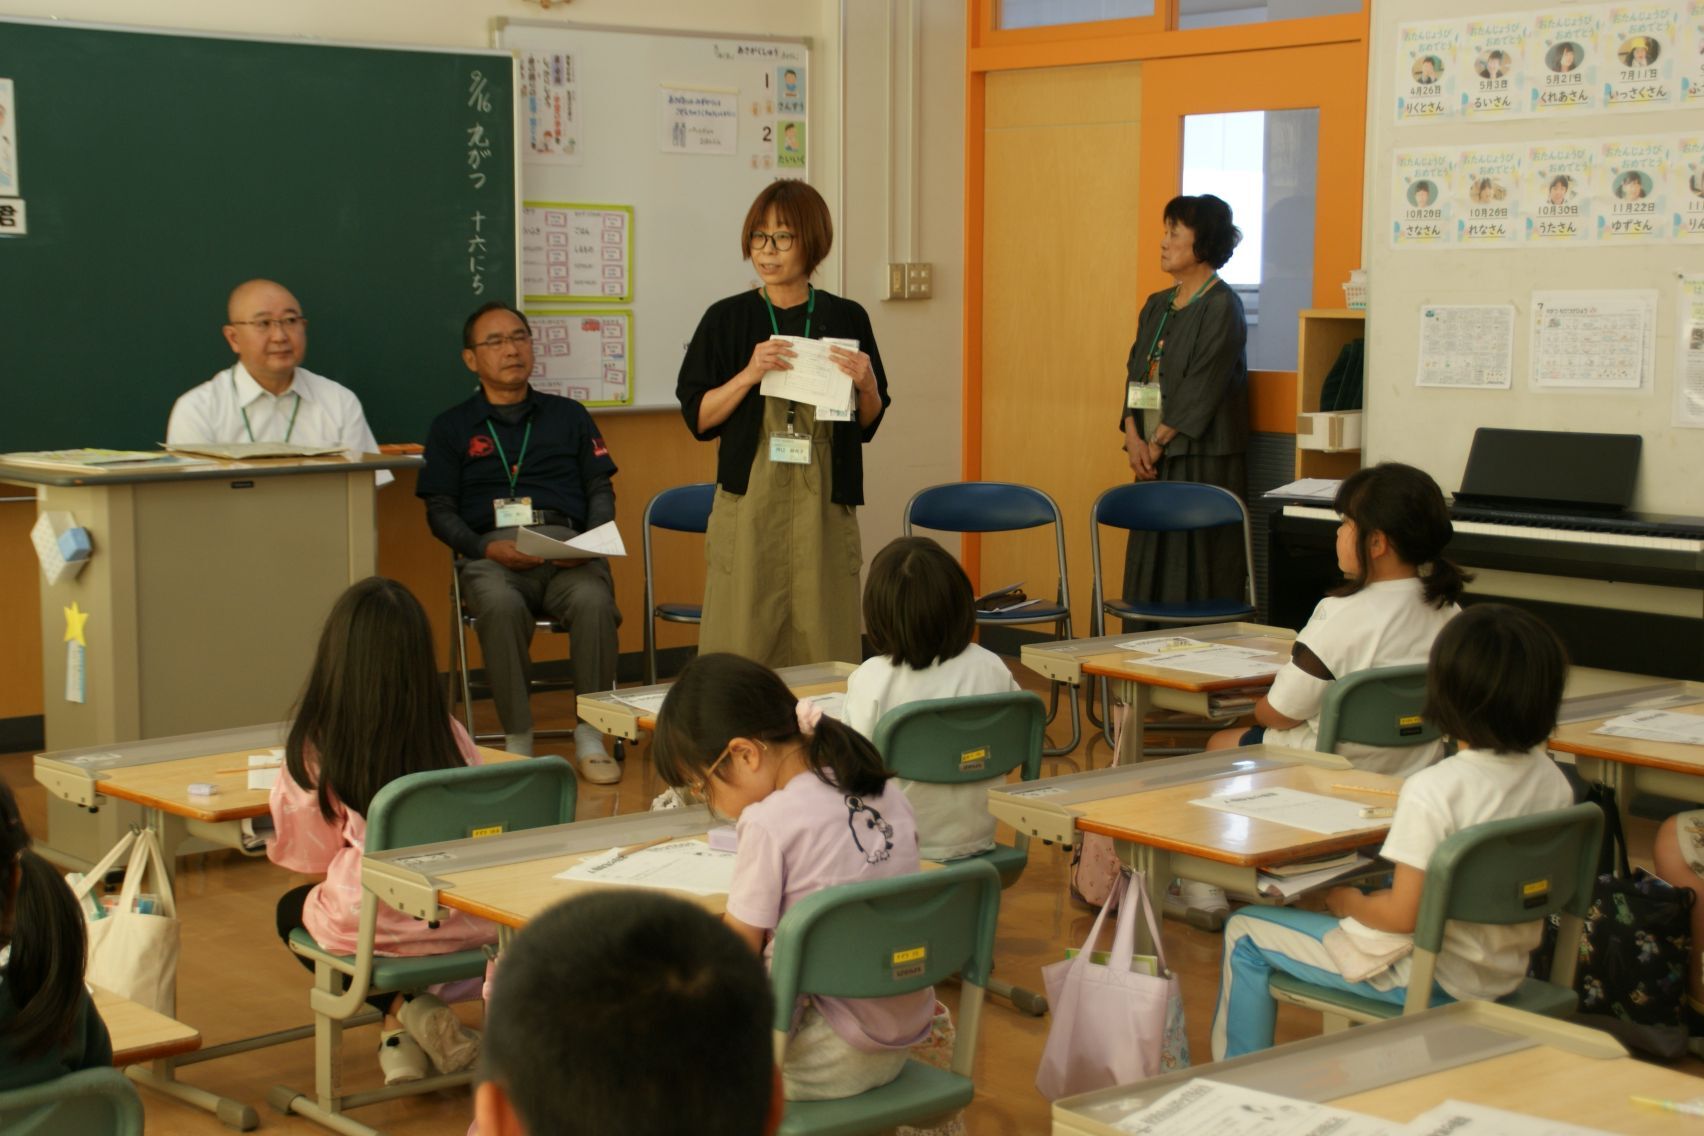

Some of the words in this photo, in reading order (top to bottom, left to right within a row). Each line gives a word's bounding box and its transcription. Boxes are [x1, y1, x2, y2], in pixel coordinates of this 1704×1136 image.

[765, 72, 770, 89] 1
[1620, 69, 1657, 81] 7月11日
[1410, 85, 1442, 96] 4月26日
[1479, 79, 1509, 90] 5月3日
[1474, 96, 1511, 108] るいさん
[1541, 90, 1588, 103] くれあさん
[1406, 101, 1444, 113] りくとさん
[763, 126, 772, 142] 2
[1538, 205, 1578, 216] 10月30日
[1613, 202, 1656, 213] 11月22日
[1406, 225, 1441, 236] さなさん
[1469, 224, 1506, 235] れなさん
[1539, 221, 1577, 233] うたさん
[1611, 218, 1653, 231] ゆずさん
[468, 211, 487, 295] 十六にち
